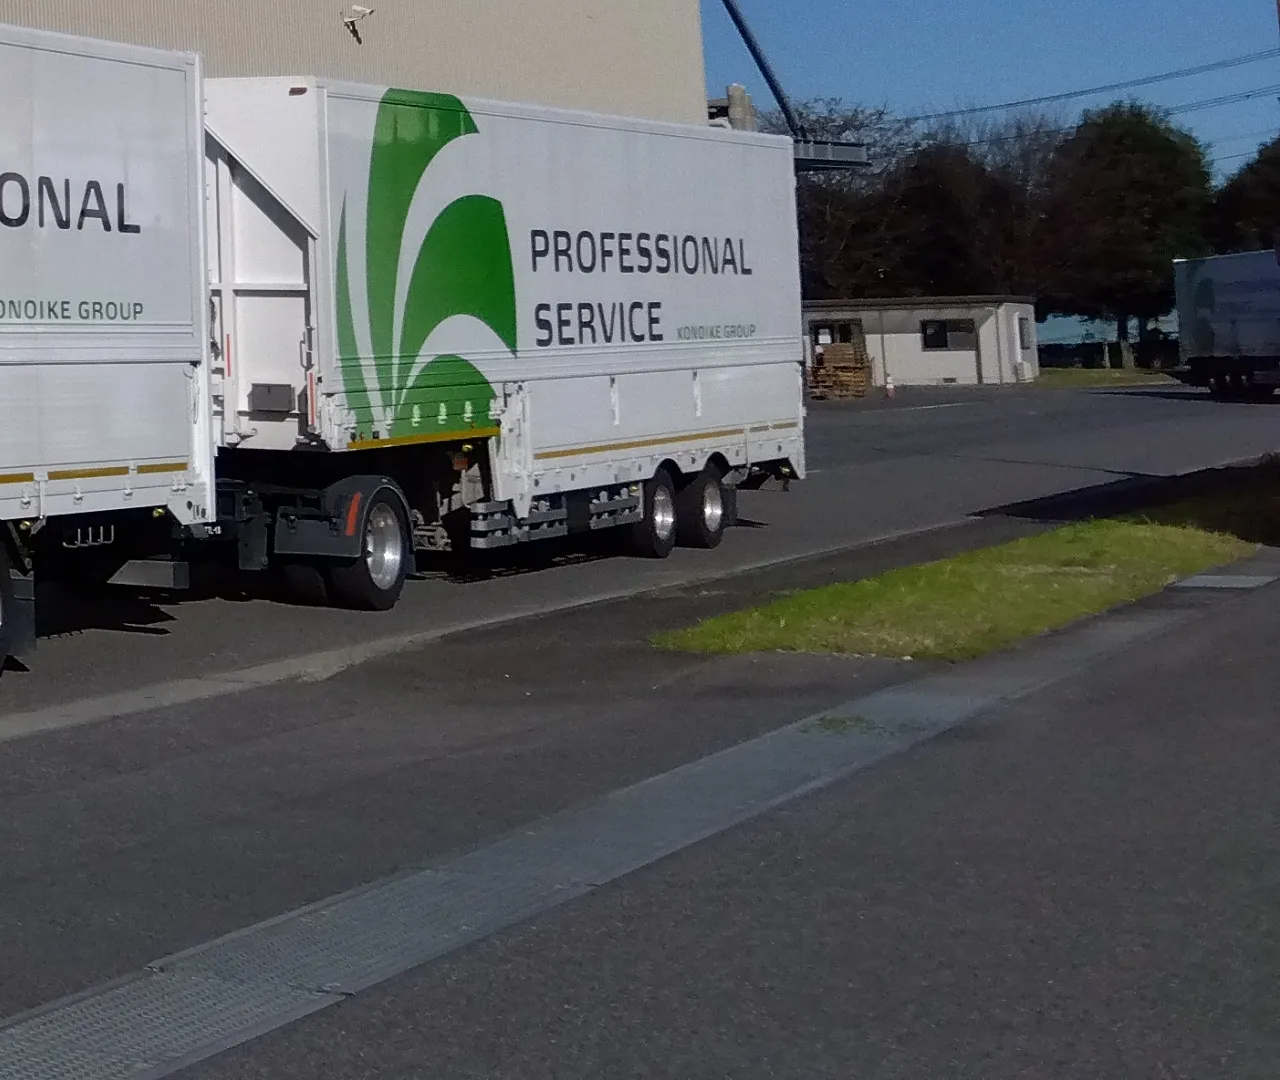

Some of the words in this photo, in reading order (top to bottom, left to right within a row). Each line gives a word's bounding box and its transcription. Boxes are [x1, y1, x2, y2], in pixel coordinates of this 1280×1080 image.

[530, 229, 752, 275] PROFESSIONAL
[78, 301, 143, 320] GROUP
[534, 301, 663, 347] SERVICE
[677, 325, 721, 340] KONOIKE
[723, 323, 756, 338] GROUP
